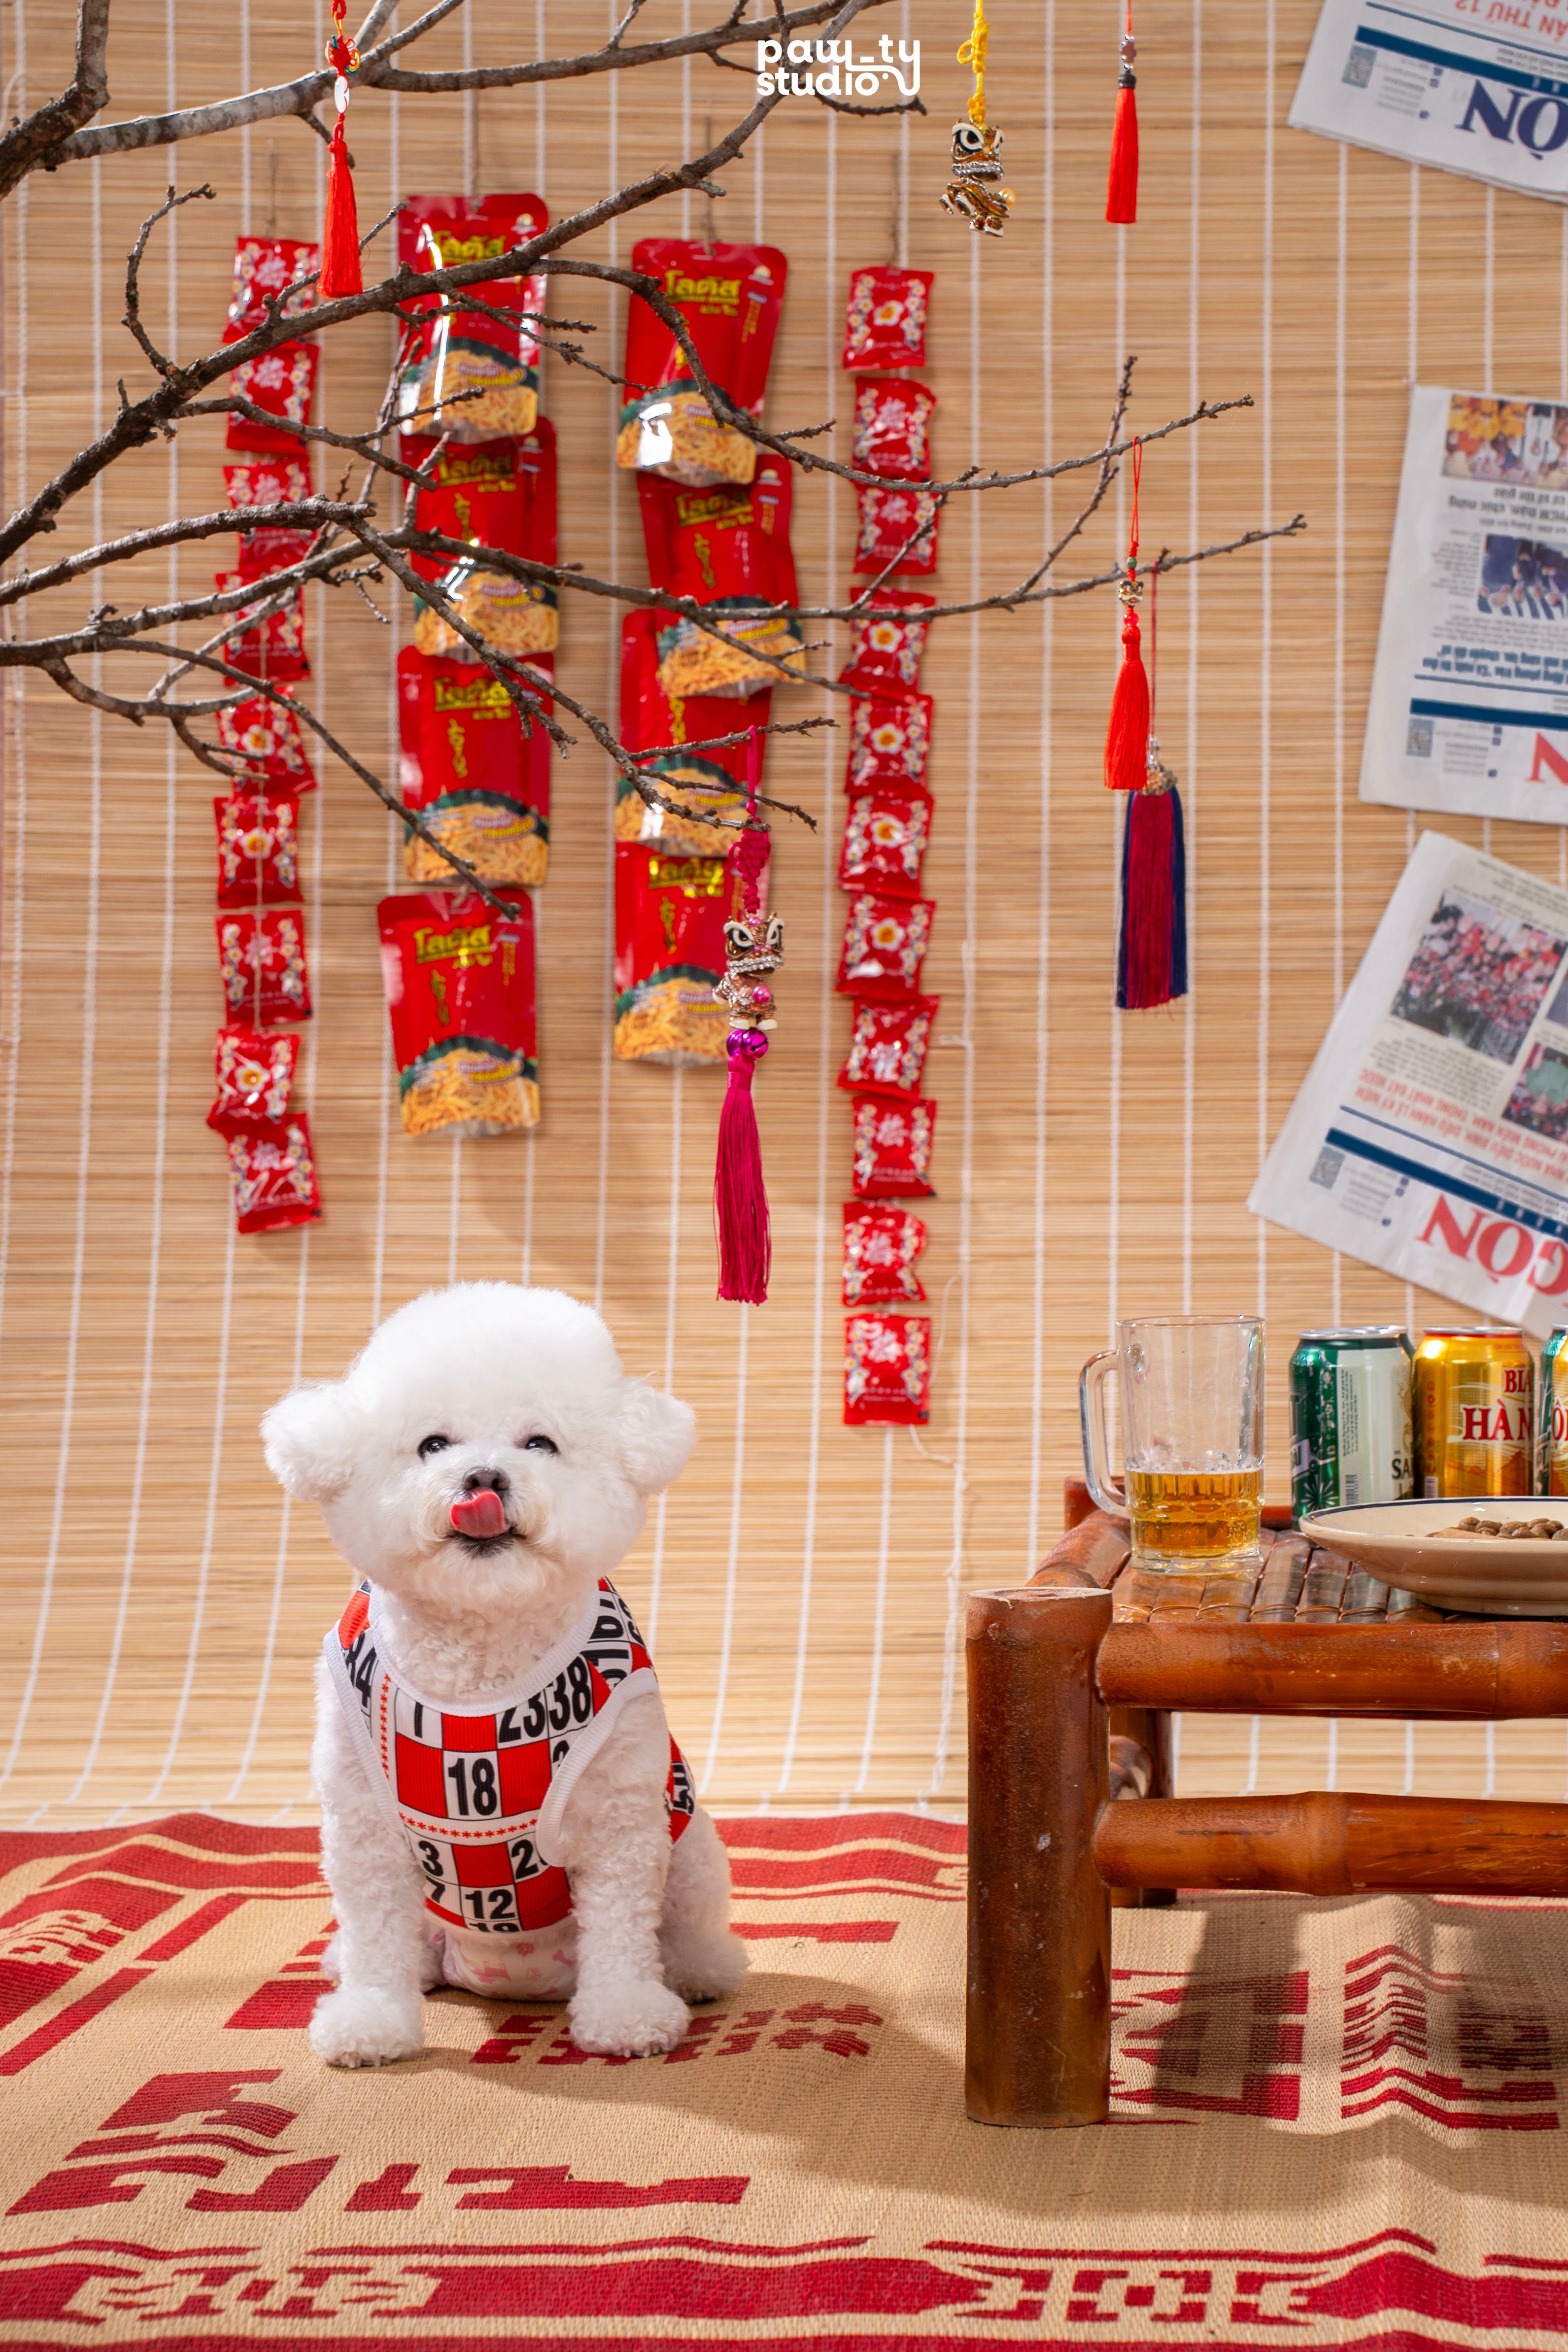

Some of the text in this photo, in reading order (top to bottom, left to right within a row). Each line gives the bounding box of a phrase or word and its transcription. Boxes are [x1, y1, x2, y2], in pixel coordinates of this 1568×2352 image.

[448, 1758, 498, 1817] 18
[418, 1840, 444, 1877] 3
[511, 1839, 548, 1880] 2
[464, 1888, 515, 1920] 12
